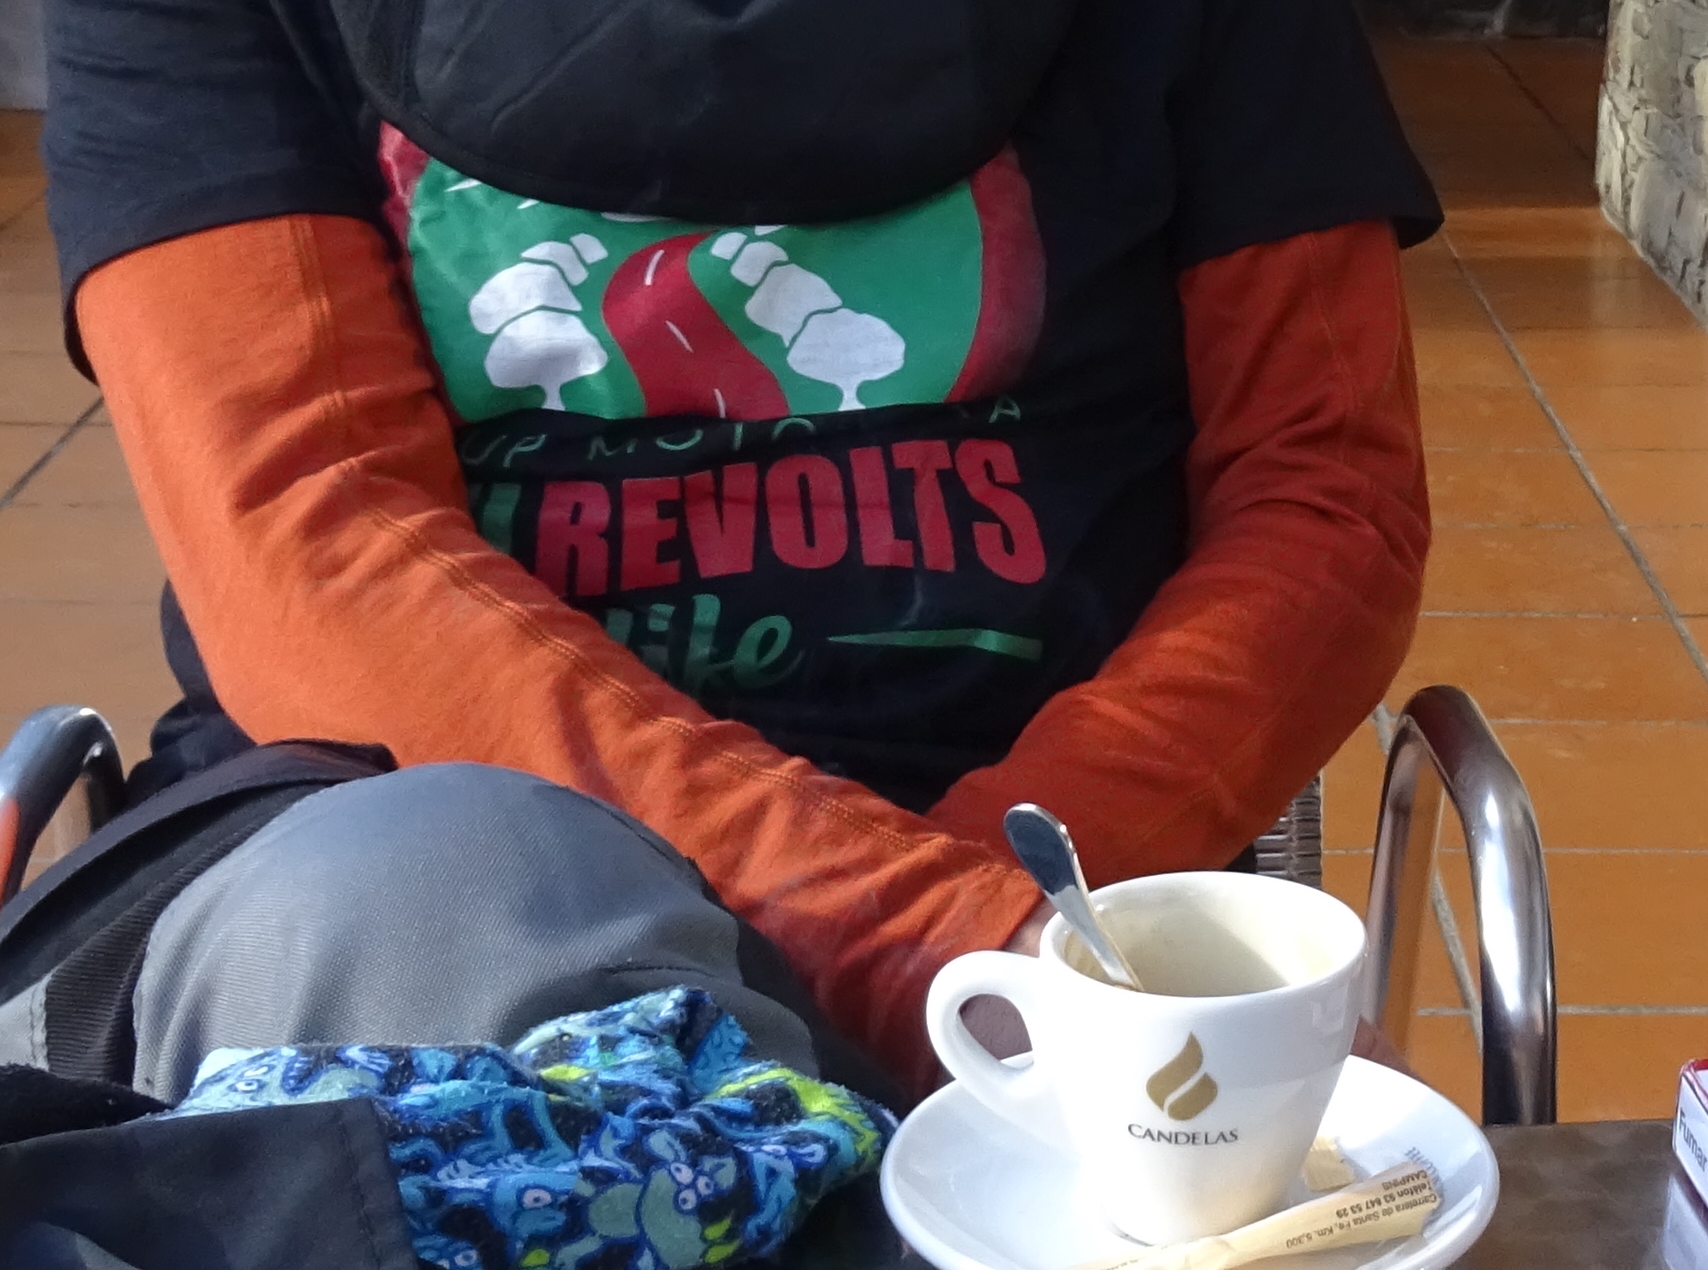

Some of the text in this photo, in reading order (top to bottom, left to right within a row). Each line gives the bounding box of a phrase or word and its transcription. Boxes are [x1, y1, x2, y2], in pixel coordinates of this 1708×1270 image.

[534, 438, 1047, 597] REVOLTS
[1127, 1123, 1239, 1145] CANDELAS
[1679, 1108, 1708, 1172] Fumar
[1381, 1206, 1394, 1216] de
[1395, 1193, 1436, 1212] Carretera
[1352, 1211, 1380, 1225] Santa
